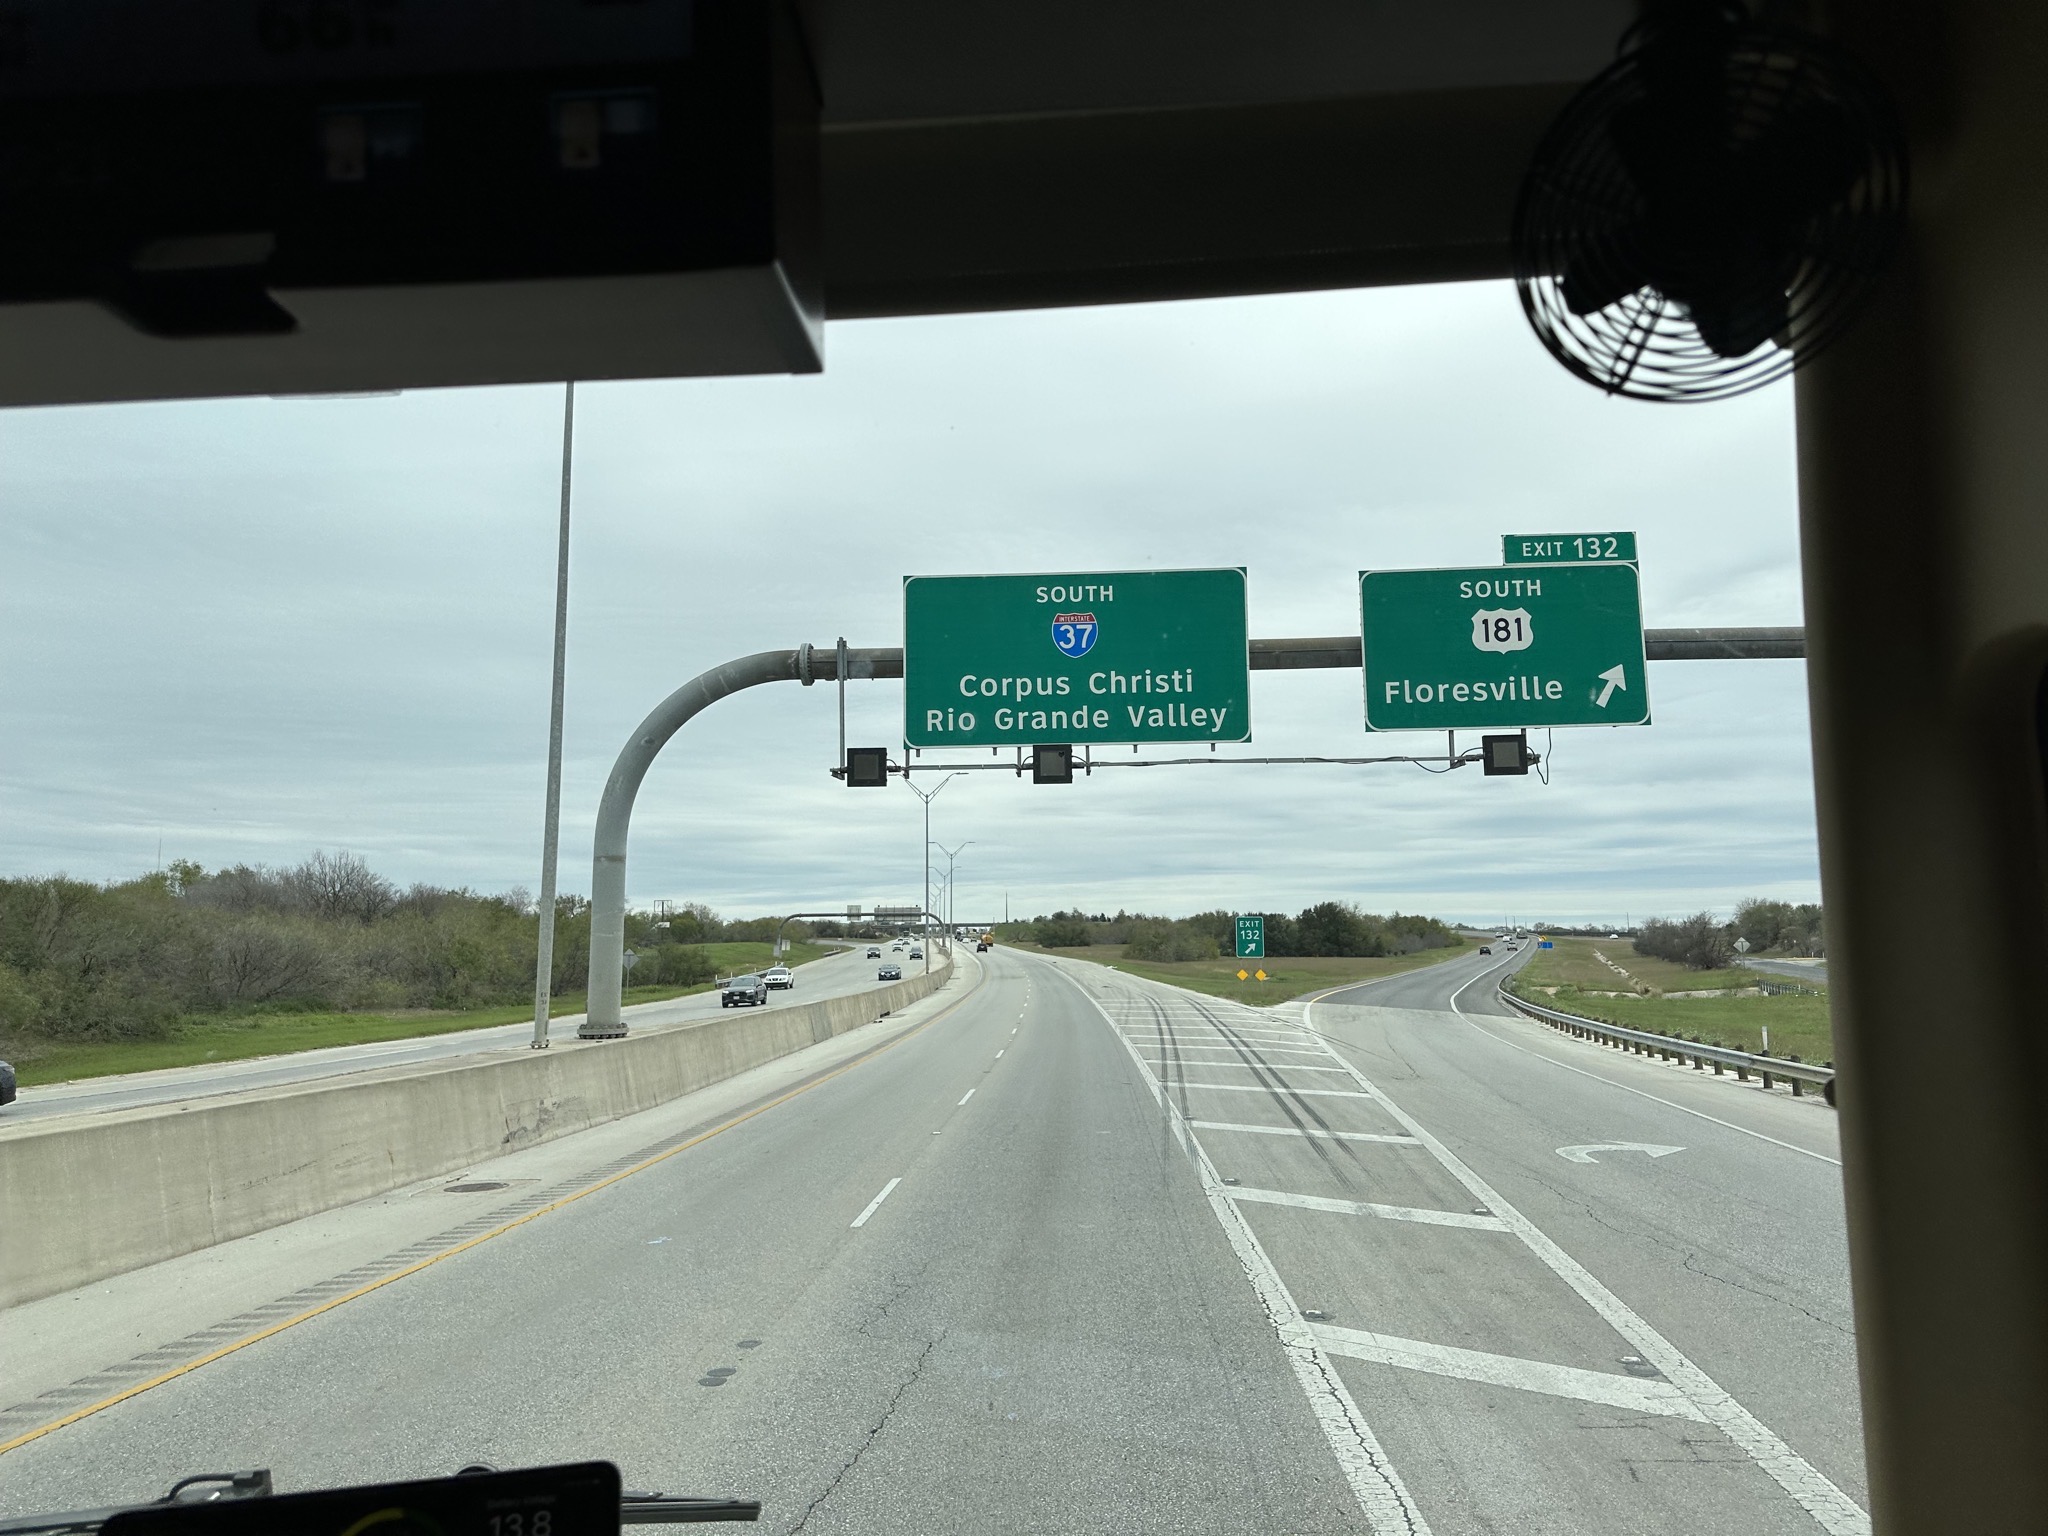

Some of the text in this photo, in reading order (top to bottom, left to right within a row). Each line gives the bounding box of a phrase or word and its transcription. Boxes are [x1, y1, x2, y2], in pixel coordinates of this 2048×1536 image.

[1522, 536, 1619, 558] EXIT 132
[1036, 585, 1114, 604] SOUTH
[1460, 579, 1542, 599] SOUTH
[1058, 615, 1090, 623] INTERSTATE
[1482, 617, 1523, 642] 181
[1059, 624, 1093, 649] 37
[959, 668, 1194, 702] Corpus Christi
[1384, 675, 1563, 704] Floresville
[926, 703, 1228, 734] Rio Grande Valley
[1239, 920, 1260, 928] EXIT
[1240, 929, 1260, 940] 132
